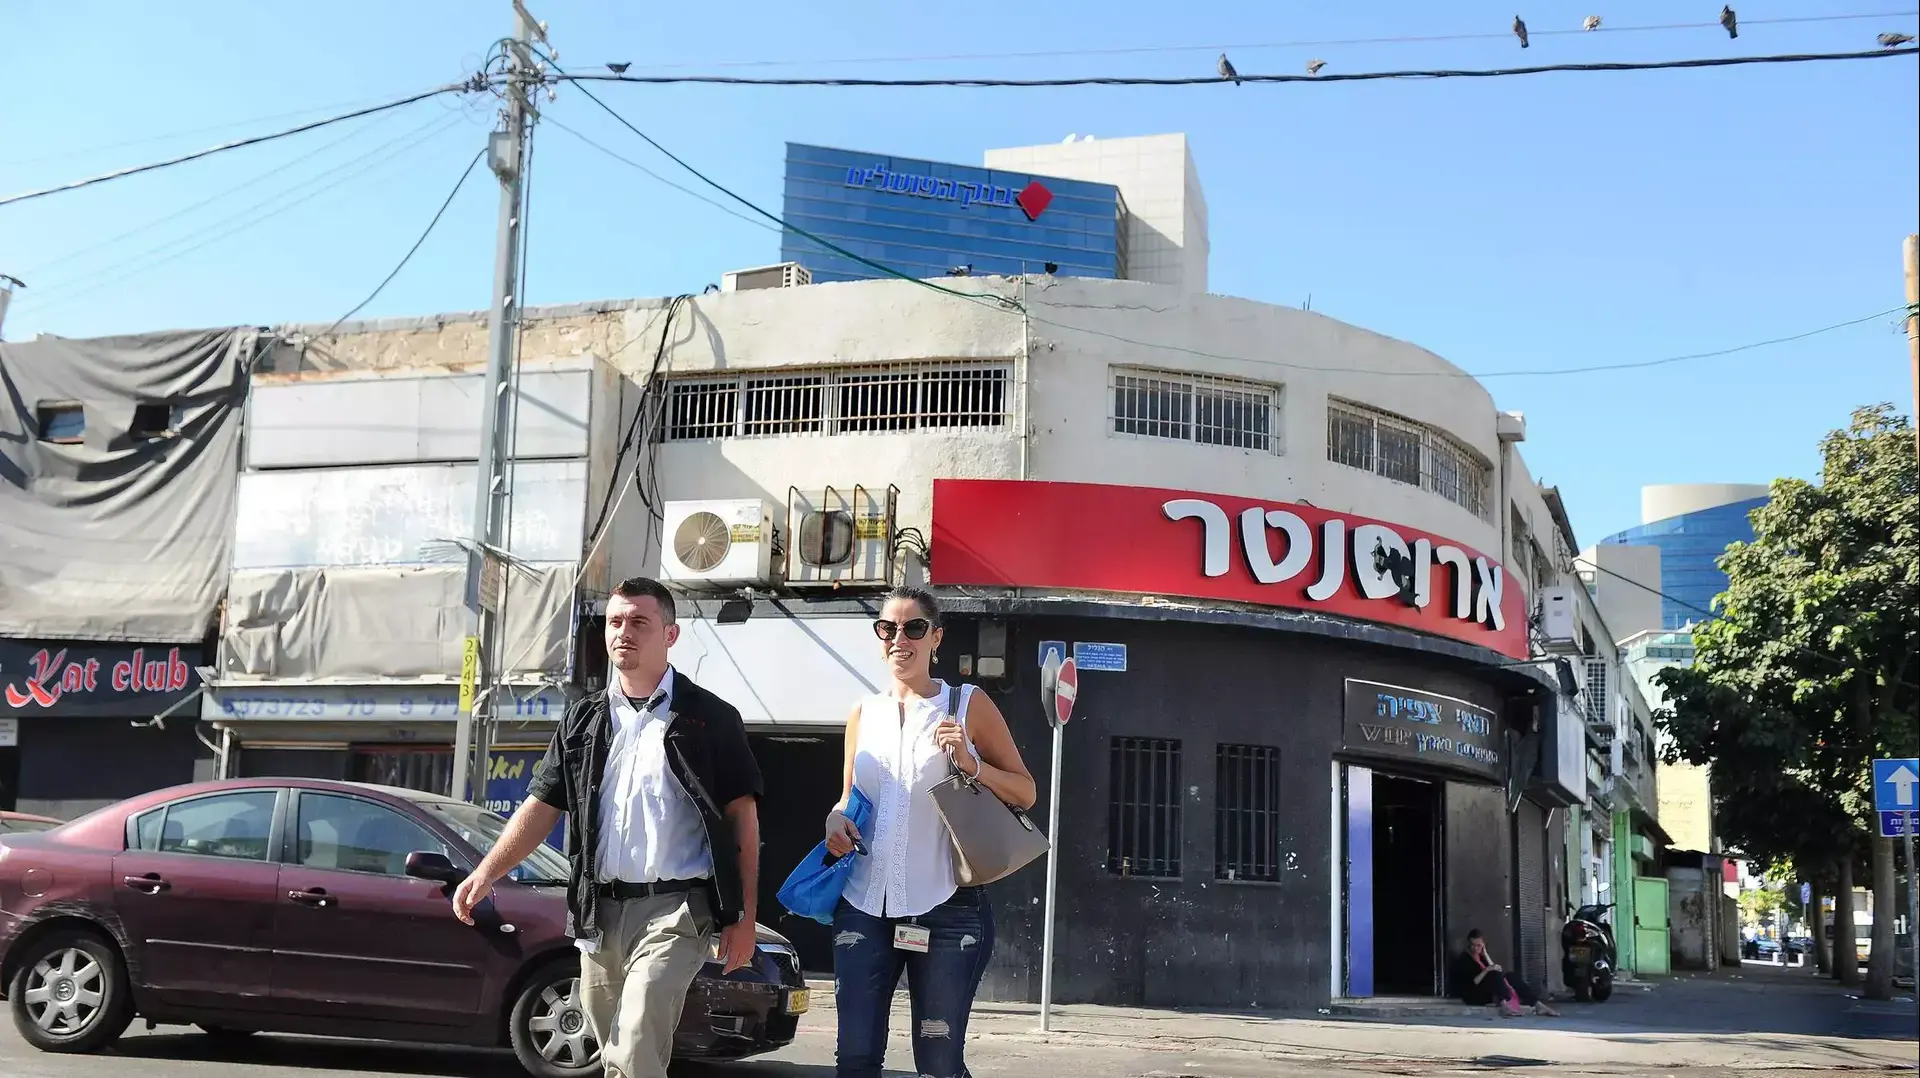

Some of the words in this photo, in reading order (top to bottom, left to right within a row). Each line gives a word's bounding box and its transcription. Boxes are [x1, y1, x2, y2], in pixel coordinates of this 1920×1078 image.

[845, 163, 960, 201] הפועלים
[960, 182, 1014, 209] בנק
[5, 647, 100, 708] Kat
[112, 647, 189, 693] club
[462, 640, 473, 696] 2943
